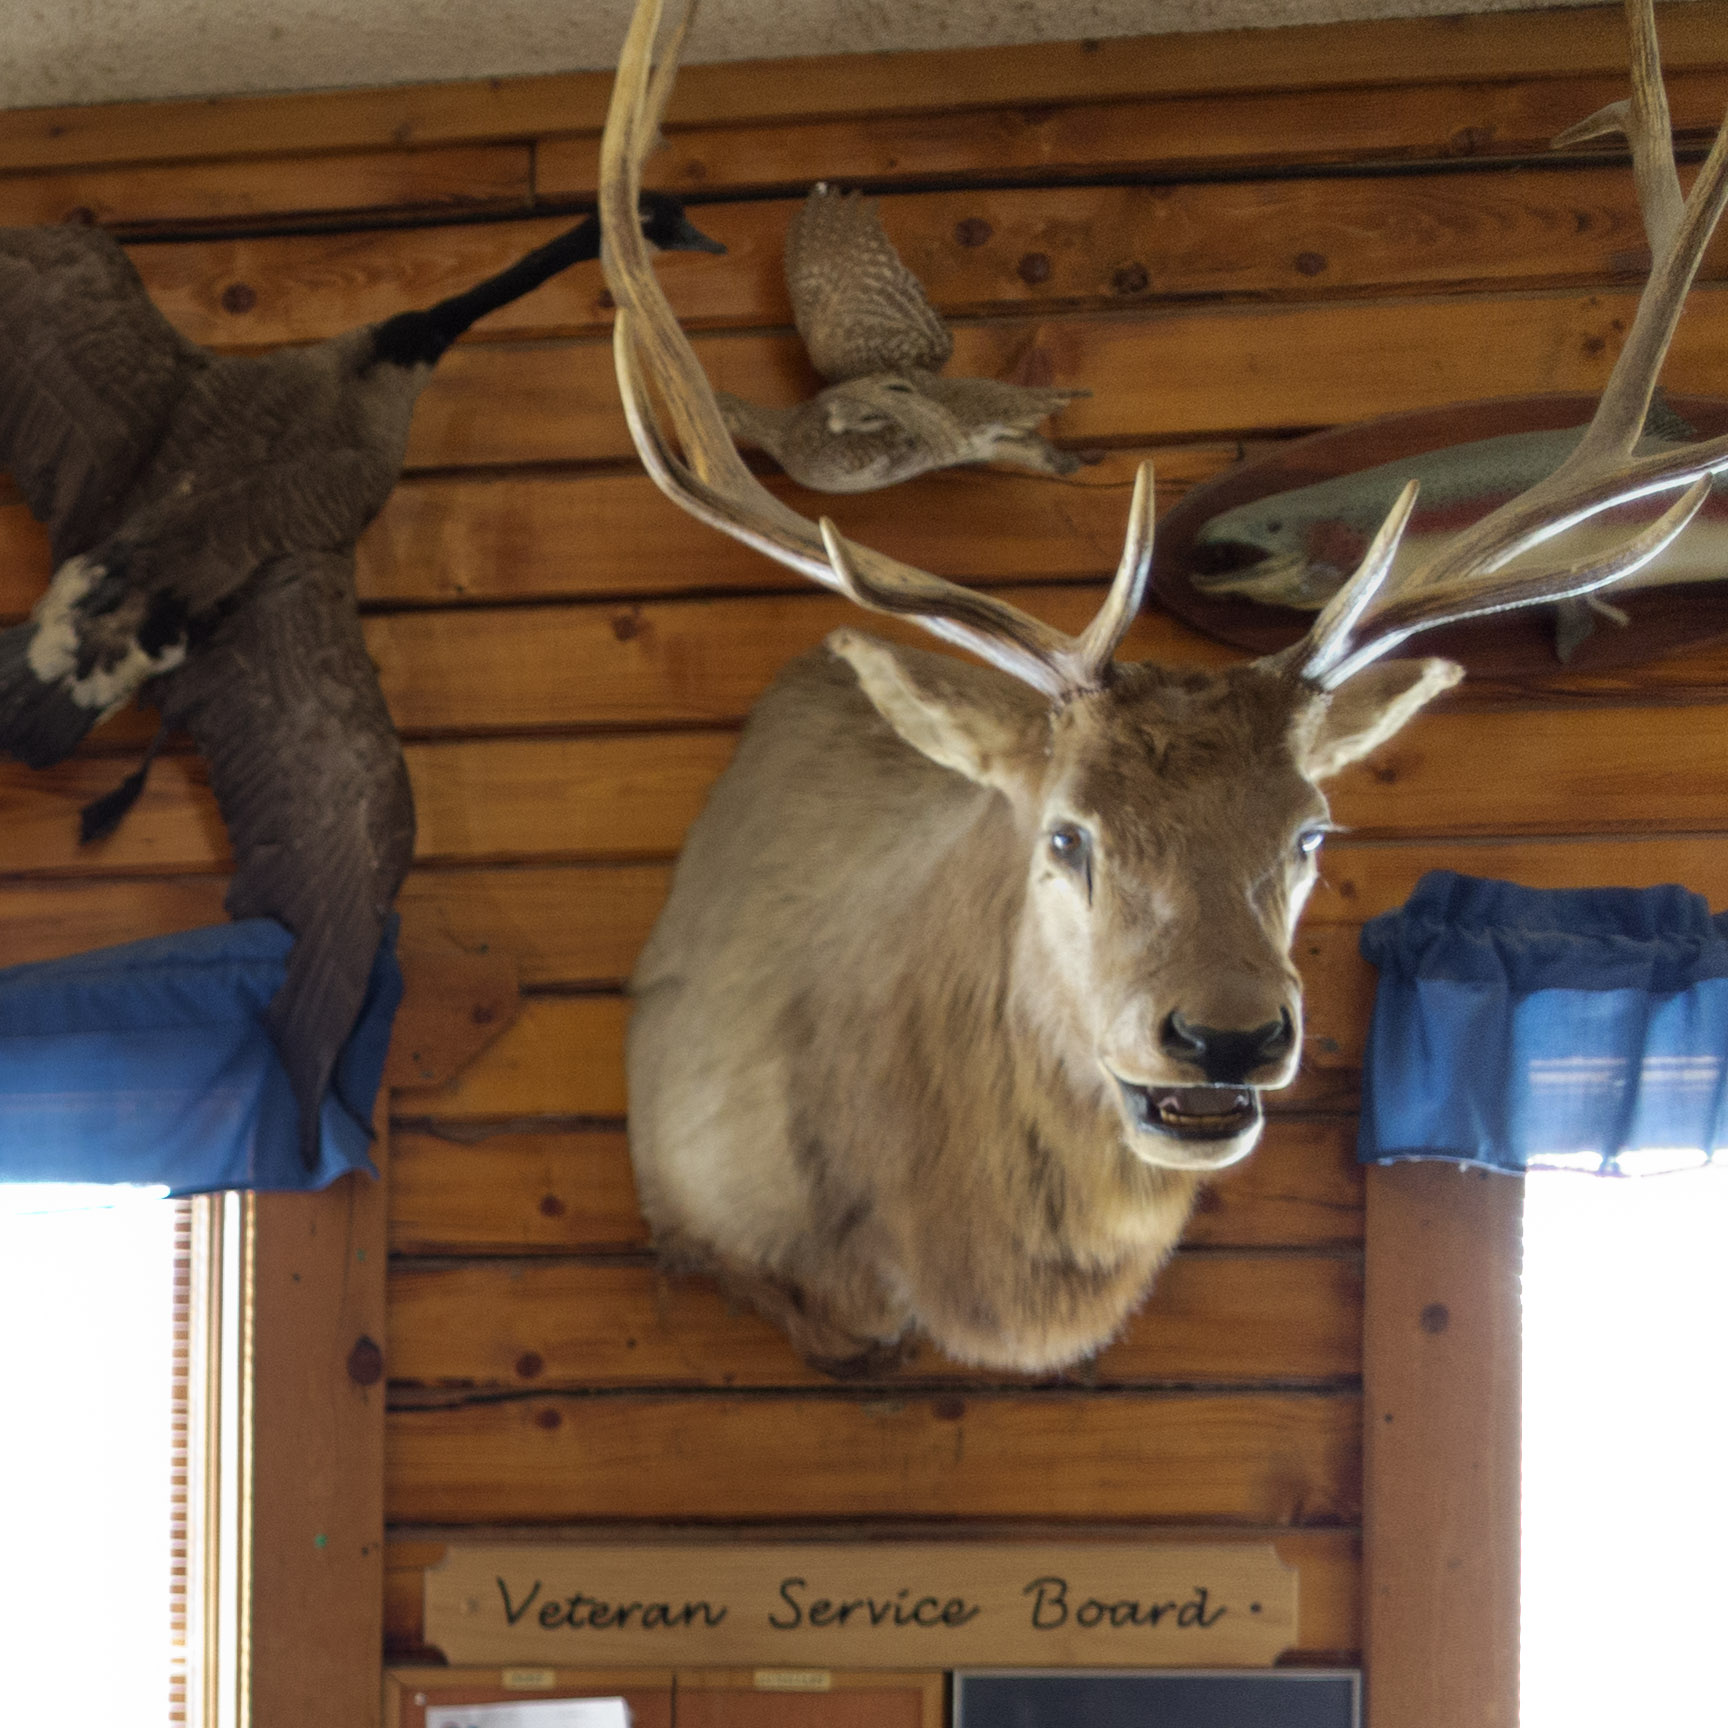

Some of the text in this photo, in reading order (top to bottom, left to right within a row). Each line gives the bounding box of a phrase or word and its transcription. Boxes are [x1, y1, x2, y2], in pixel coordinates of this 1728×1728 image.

[497, 1576, 1228, 1630] Veteran Service Board
